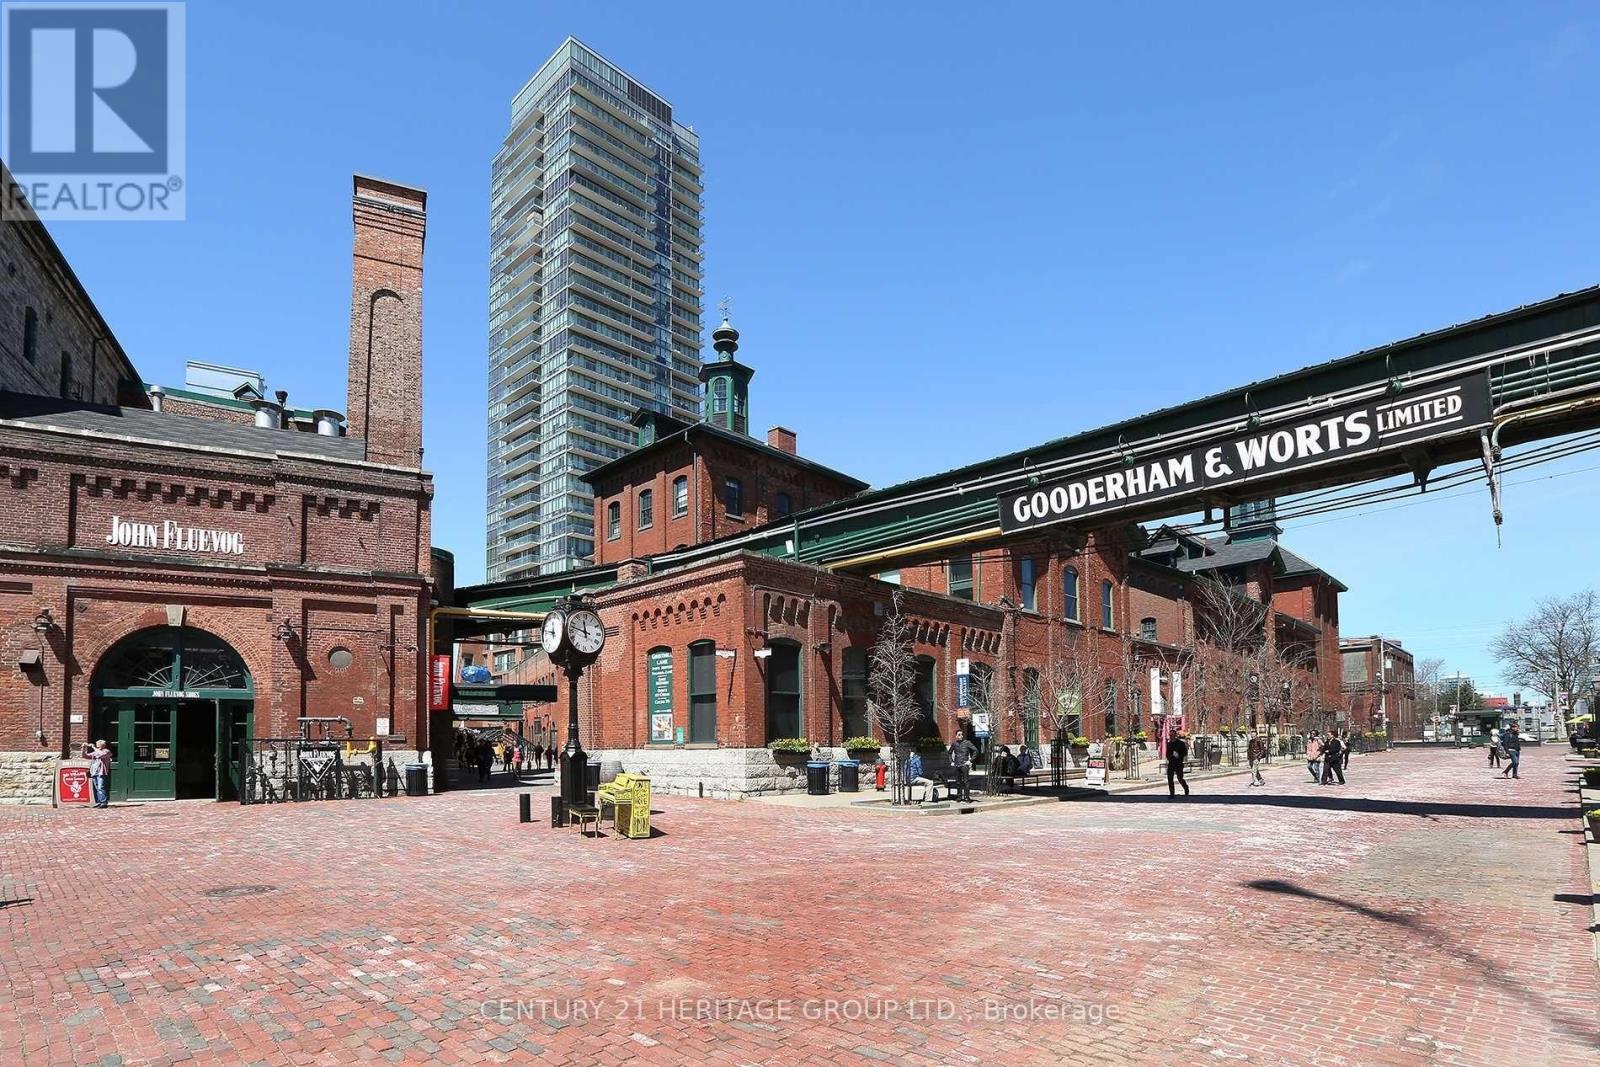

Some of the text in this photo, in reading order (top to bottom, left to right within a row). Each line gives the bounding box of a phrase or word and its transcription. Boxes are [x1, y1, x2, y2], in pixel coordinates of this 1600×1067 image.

[1012, 394, 1463, 524] GOODERHAM & WORTS LIMITED
[106, 515, 246, 555] JOHN FLUEVOG
